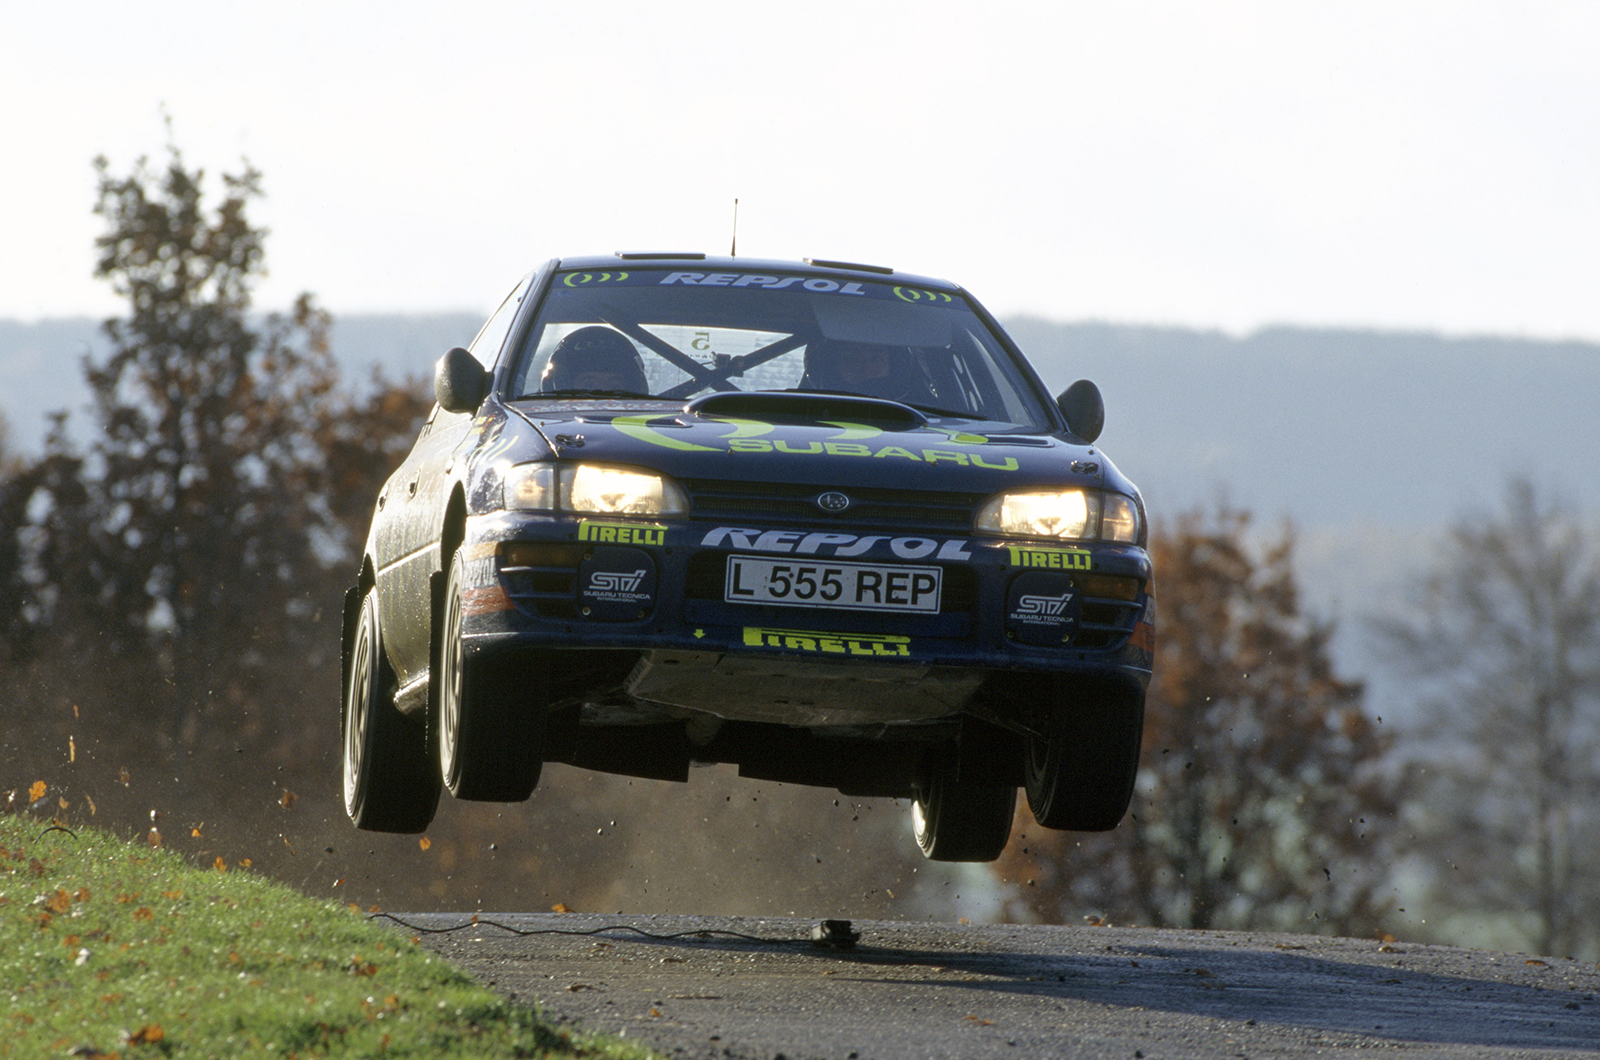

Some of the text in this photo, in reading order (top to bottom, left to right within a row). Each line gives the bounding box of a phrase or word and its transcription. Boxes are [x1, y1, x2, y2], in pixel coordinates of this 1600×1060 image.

[659, 271, 866, 296] REPSOL
[728, 438, 1020, 472] SUBARU
[577, 520, 669, 546] PIRELLI
[700, 526, 972, 562] REPSOL
[1007, 545, 1092, 571] PIRELLI
[583, 590, 651, 600] SUBARU TECNICA
[732, 562, 937, 606] L 555 REP
[1010, 613, 1042, 621] SUBARU
[743, 626, 911, 656] PIRELLI
